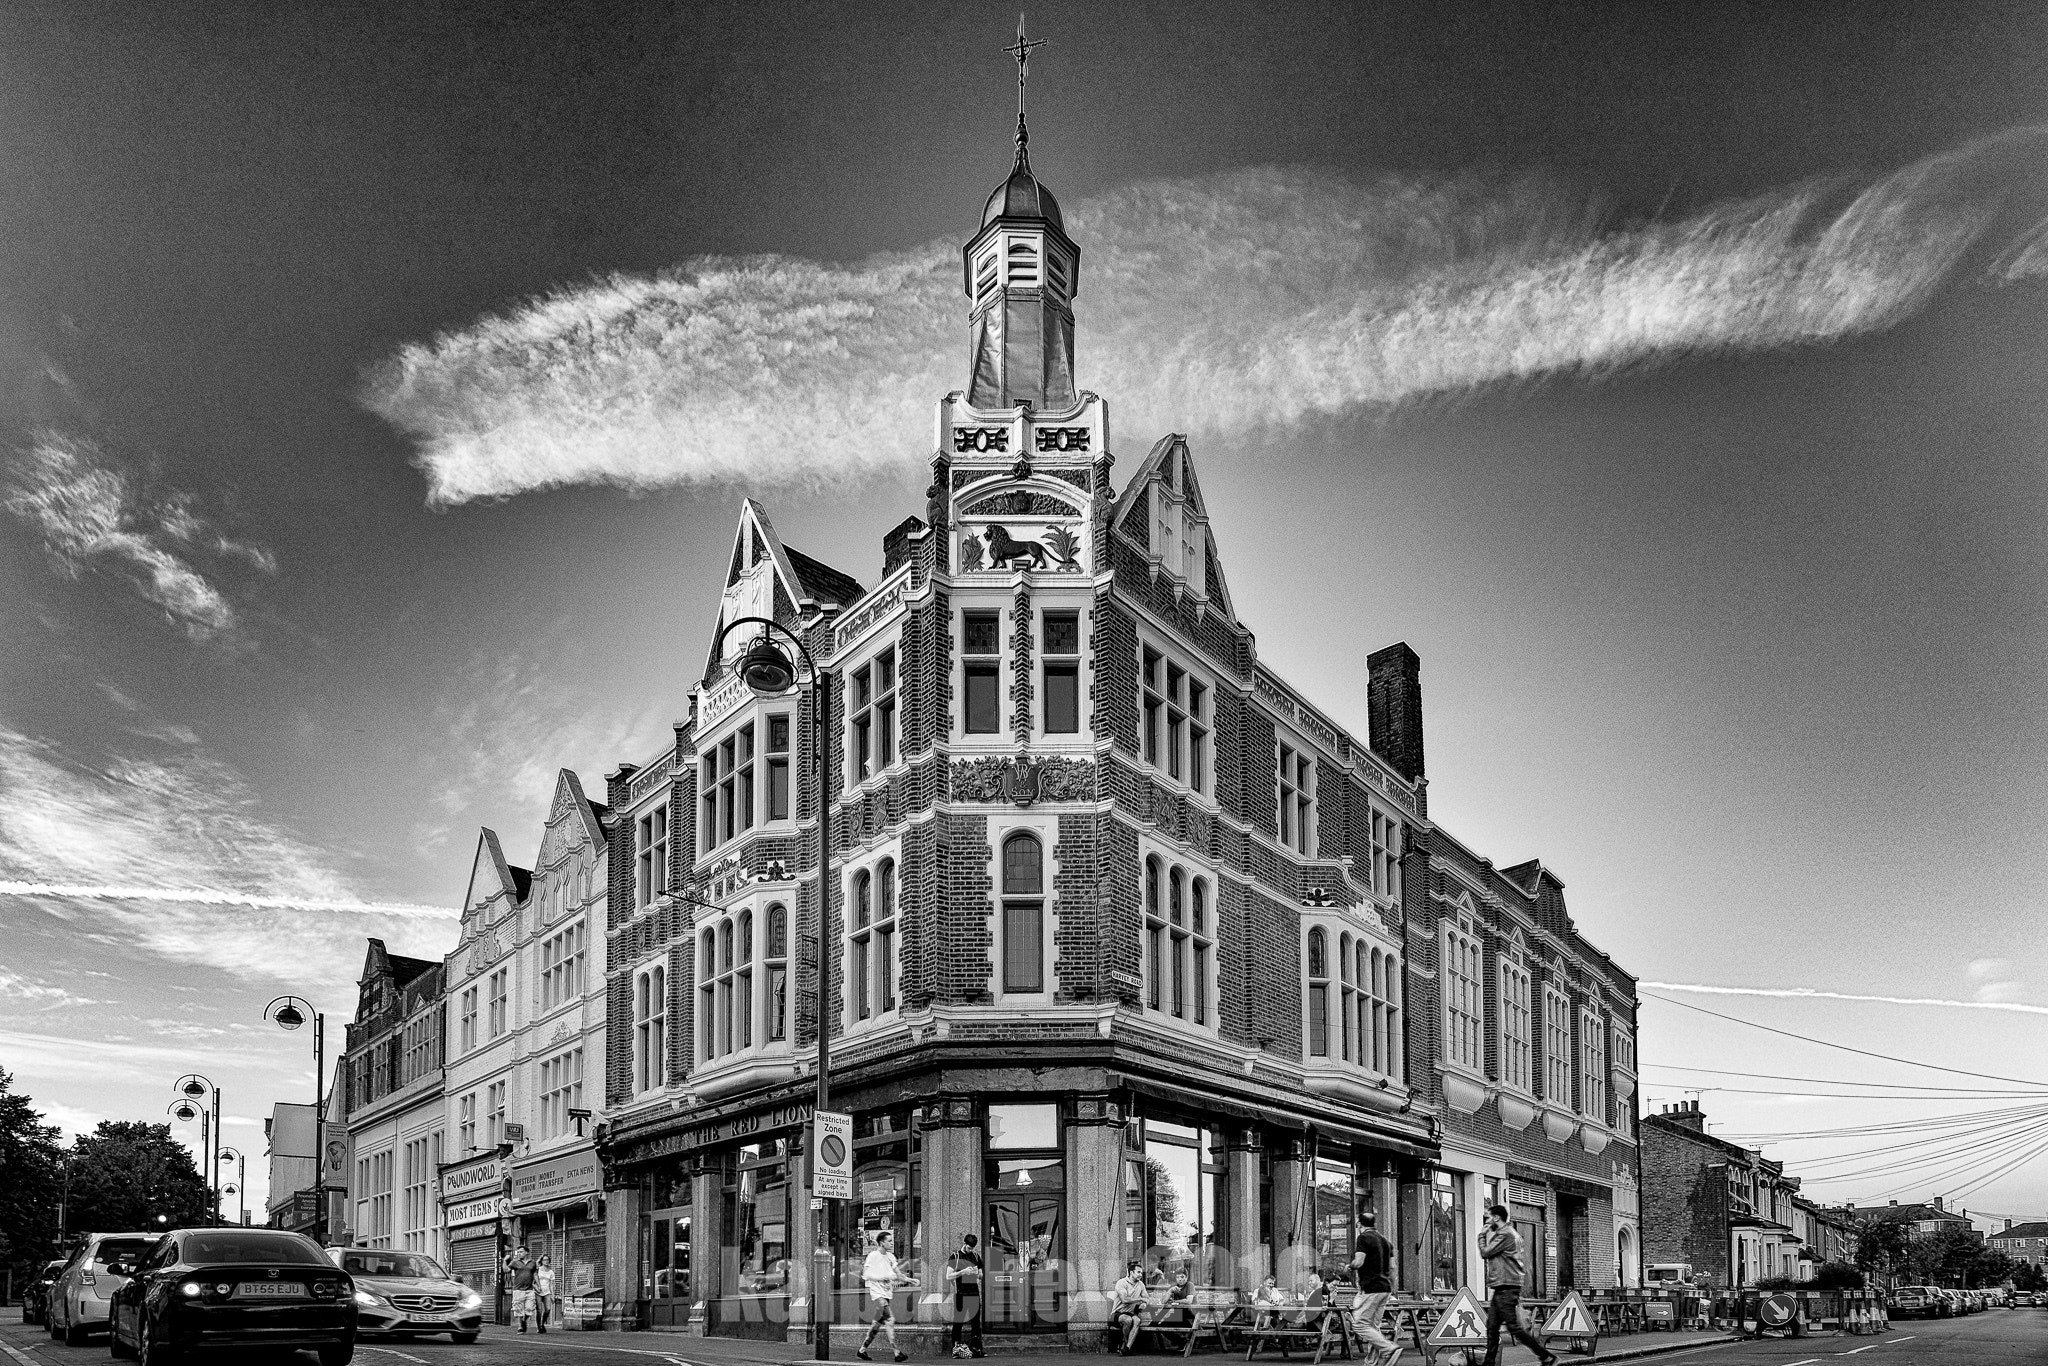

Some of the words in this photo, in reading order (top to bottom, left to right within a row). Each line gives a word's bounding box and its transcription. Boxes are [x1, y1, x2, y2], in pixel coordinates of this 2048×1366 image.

[693, 1125, 720, 1145] THE
[730, 1116, 759, 1136] RED
[771, 1104, 813, 1126] LION
[816, 1114, 850, 1125] Restricted
[824, 1123, 843, 1134] Zone
[447, 1164, 495, 1190] POUNDWORLD
[515, 1175, 536, 1186] WESTERN
[539, 1170, 556, 1179] MONEY
[567, 1170, 580, 1179] EKTA
[580, 1165, 594, 1175] NEWS
[828, 1168, 847, 1176] loading
[521, 1184, 536, 1193] UNION
[539, 1177, 564, 1189] TRANSFER
[836, 1177, 848, 1185] time
[818, 1189, 835, 1197] signed
[836, 1190, 848, 1198] bays
[449, 1206, 468, 1222] MOST
[469, 1200, 492, 1218] ITEMS
[244, 1284, 275, 1294] BT55
[277, 1284, 300, 1294] EJU
